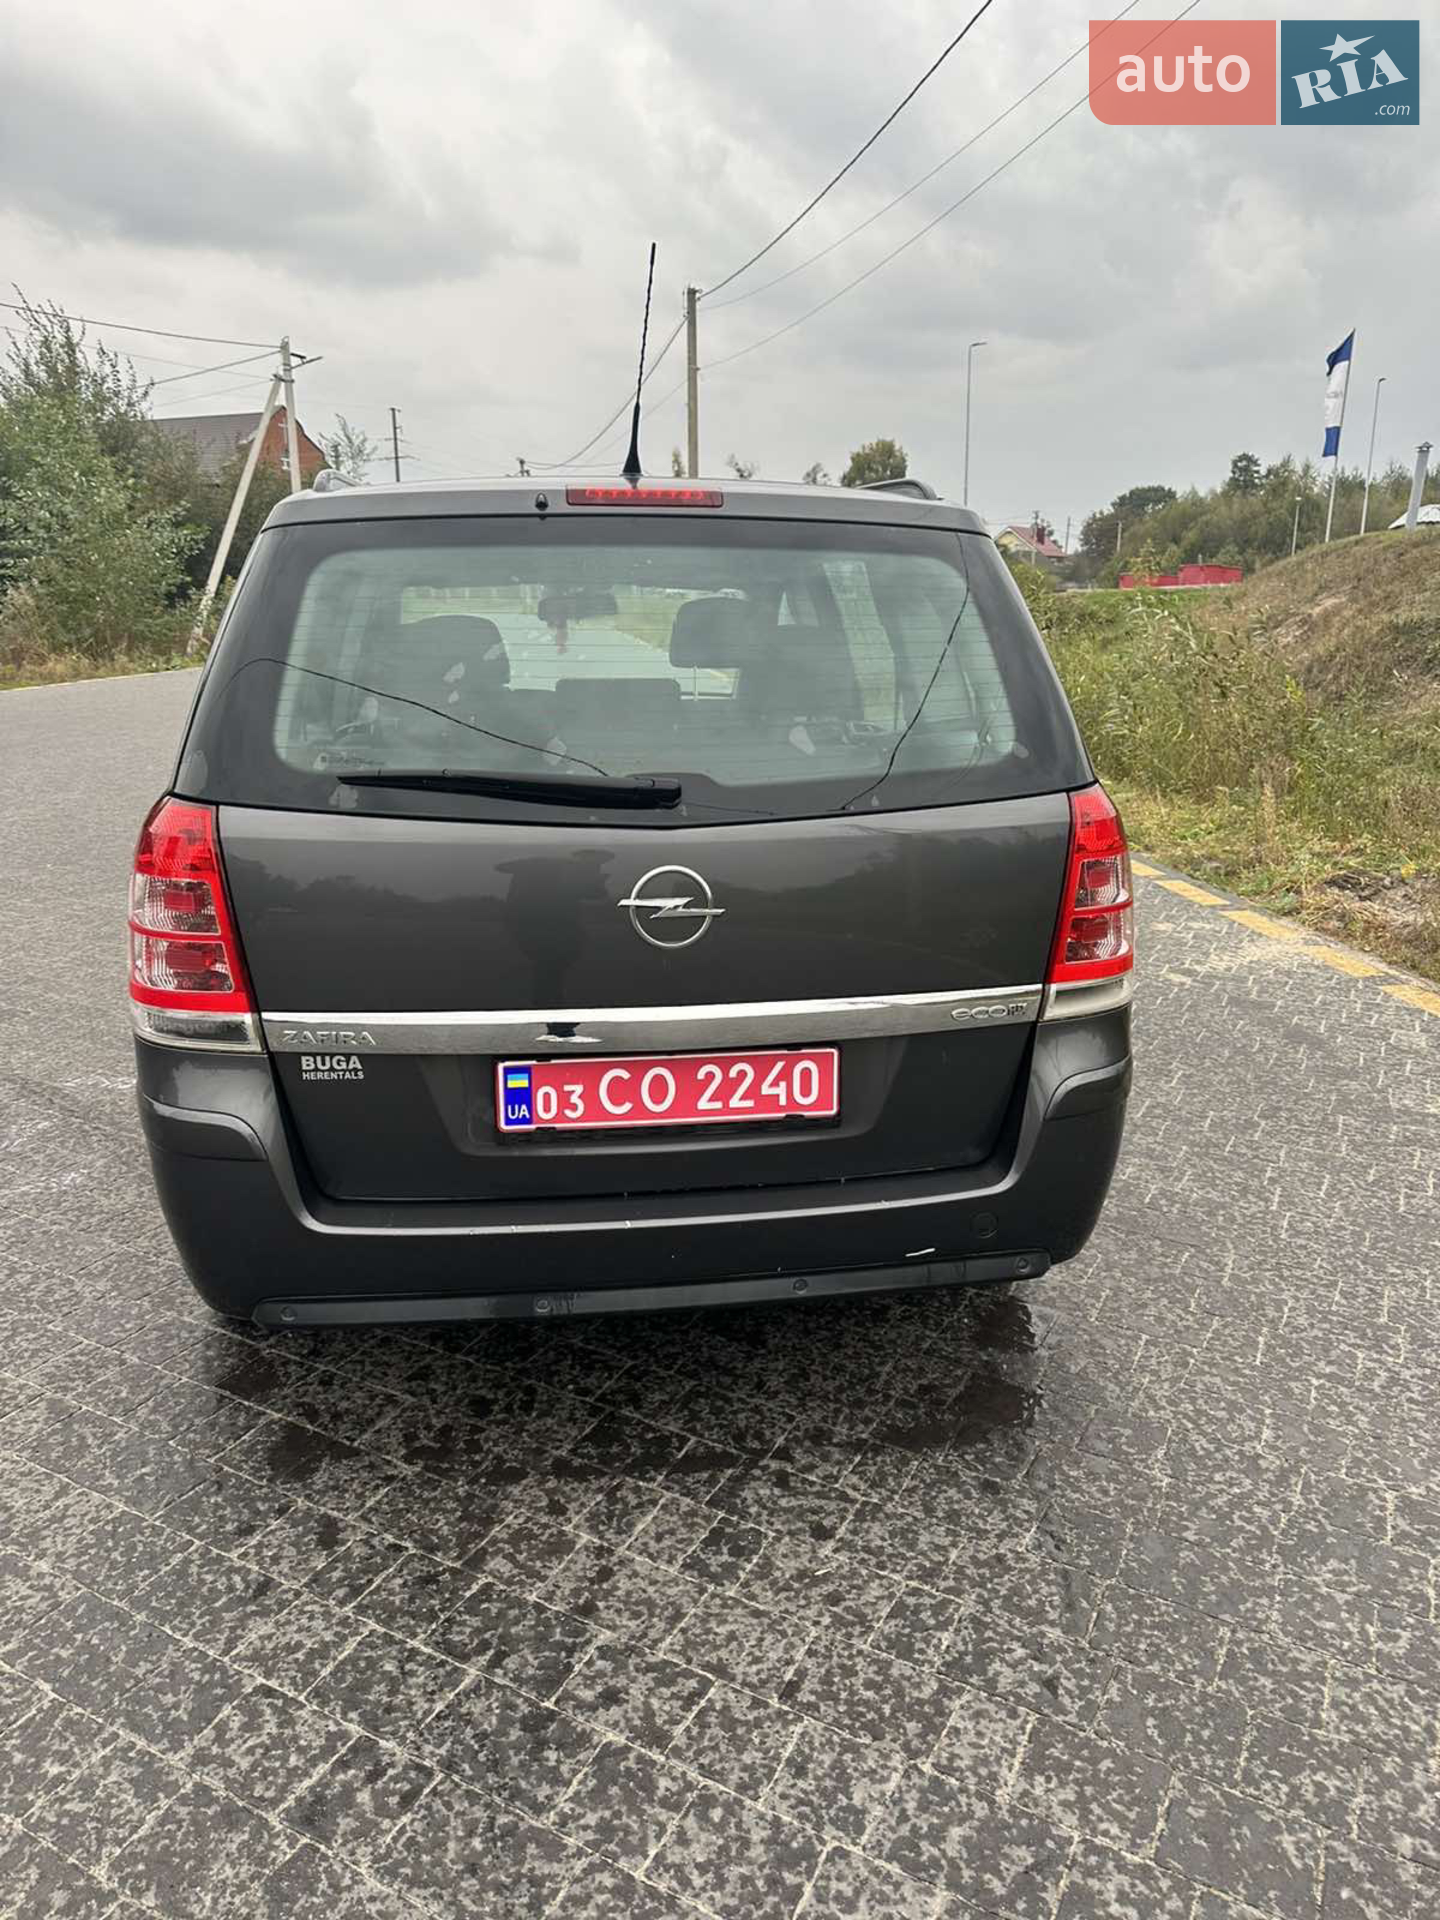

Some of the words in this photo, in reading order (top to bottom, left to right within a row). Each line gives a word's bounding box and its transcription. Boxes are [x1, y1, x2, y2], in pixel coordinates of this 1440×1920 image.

[282, 1030, 377, 1046] ZAFIRA
[301, 1055, 363, 1071] BUGA
[302, 1071, 365, 1080] HERENTALS
[536, 1084, 586, 1120] 03
[599, 1066, 677, 1115] CO
[696, 1059, 819, 1110] 2240
[507, 1104, 530, 1119] UA
